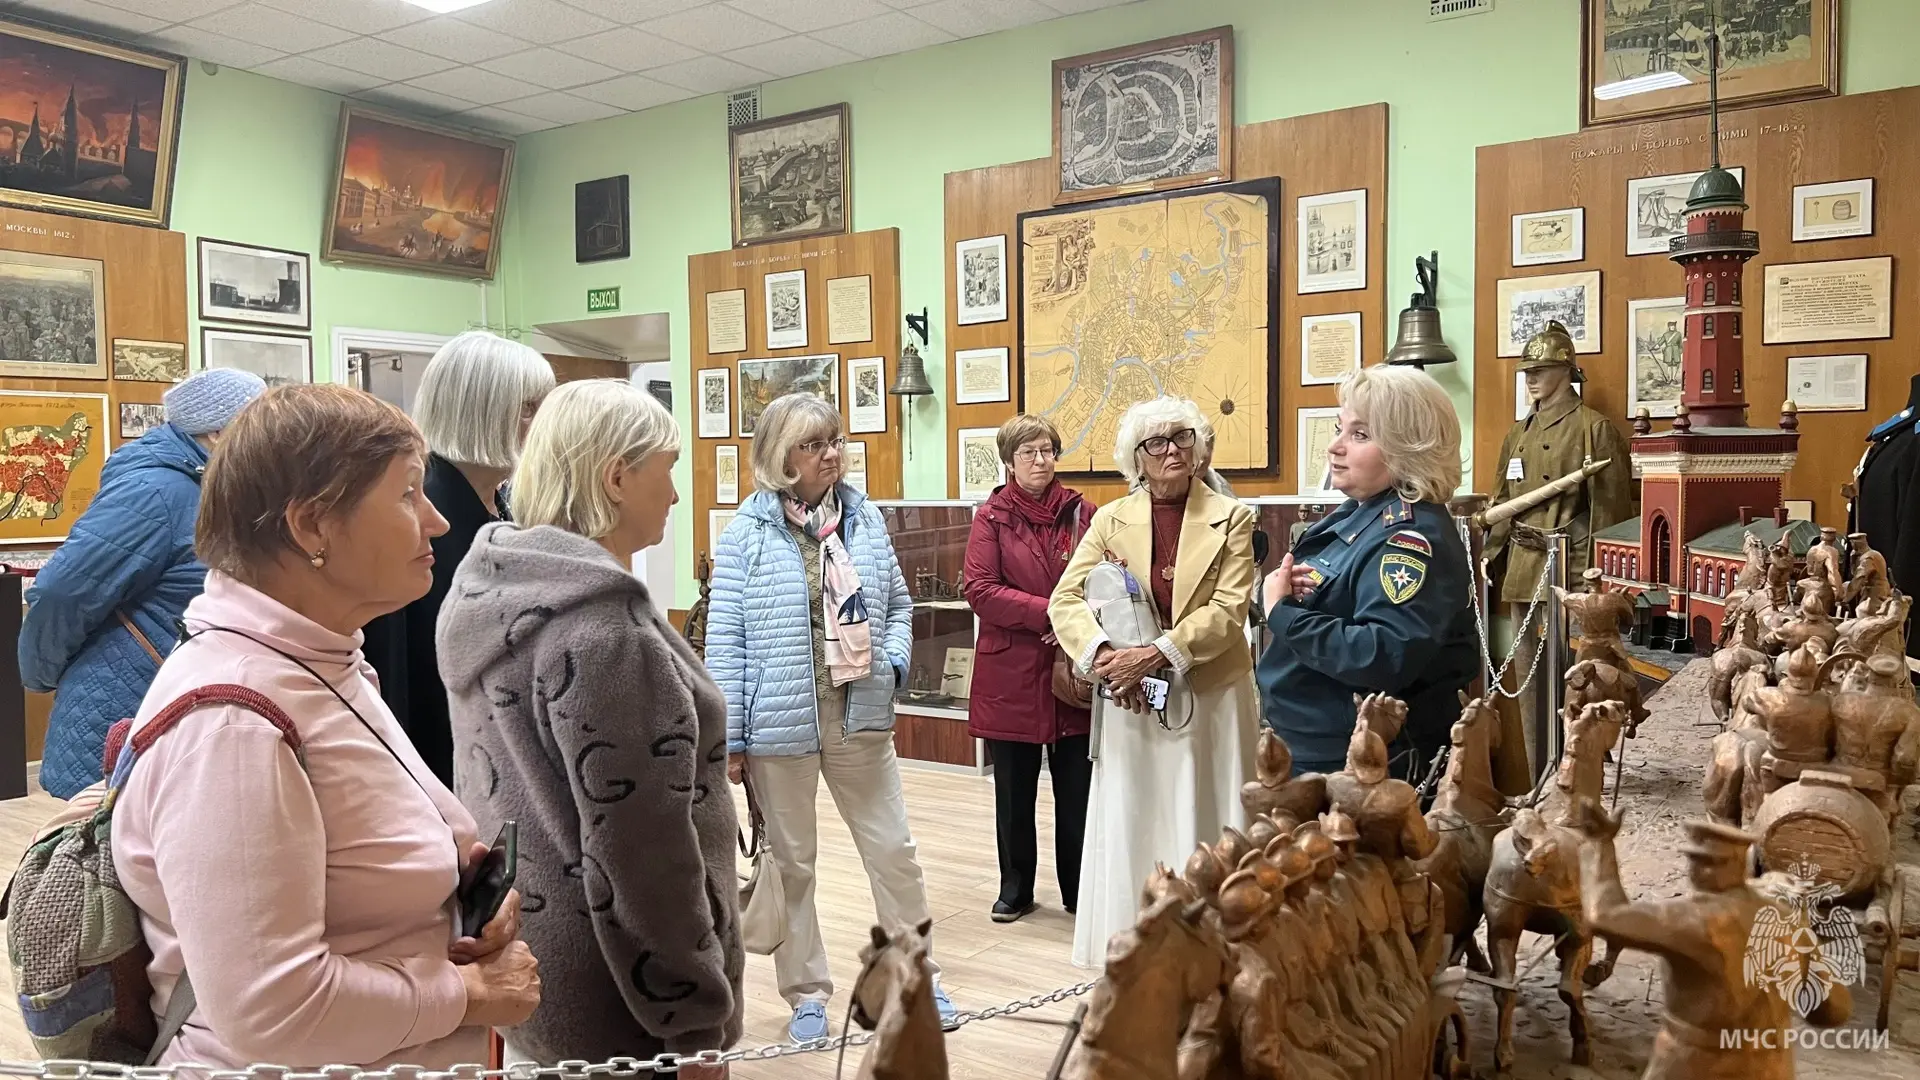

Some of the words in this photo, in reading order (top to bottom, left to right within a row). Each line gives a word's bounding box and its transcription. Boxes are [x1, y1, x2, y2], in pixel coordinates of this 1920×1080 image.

[1571, 145, 1623, 159] ПОЖАРЫ
[1631, 143, 1639, 152] И
[1645, 136, 1691, 150] БОРЬБА
[1699, 134, 1707, 143] С
[1760, 123, 1790, 135] 17-18
[6, 223, 47, 236] МОСКВЫ
[590, 290, 616, 308] ВЫХОД
